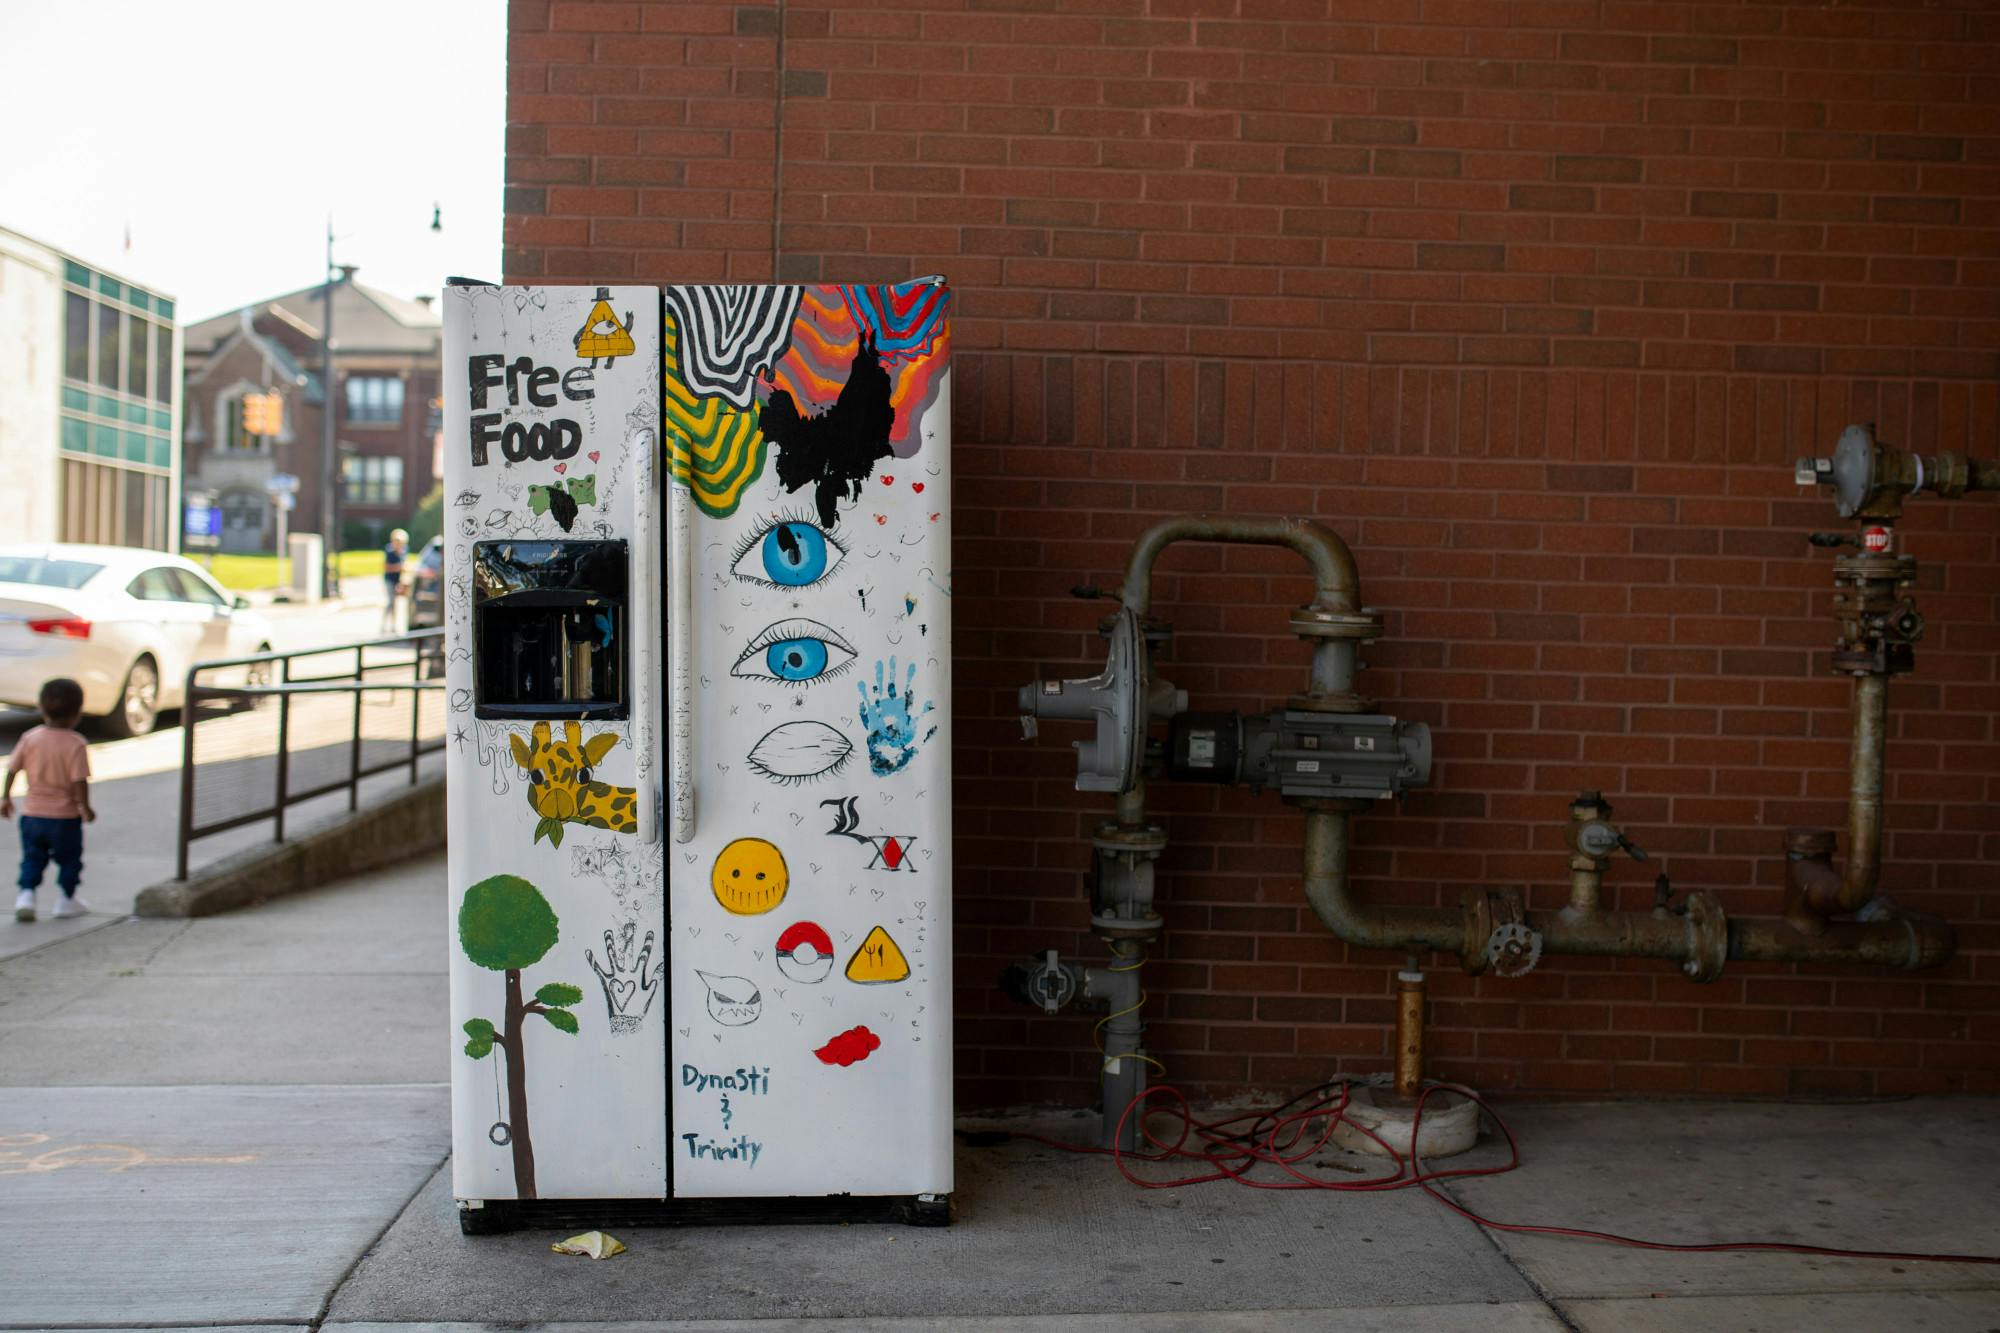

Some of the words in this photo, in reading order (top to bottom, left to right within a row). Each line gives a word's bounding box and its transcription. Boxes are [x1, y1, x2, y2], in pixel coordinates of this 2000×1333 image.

[469, 354, 595, 410] Free
[470, 413, 582, 467] FOOD
[1865, 533, 1888, 547] STOP
[682, 1133, 762, 1169] Trinity
